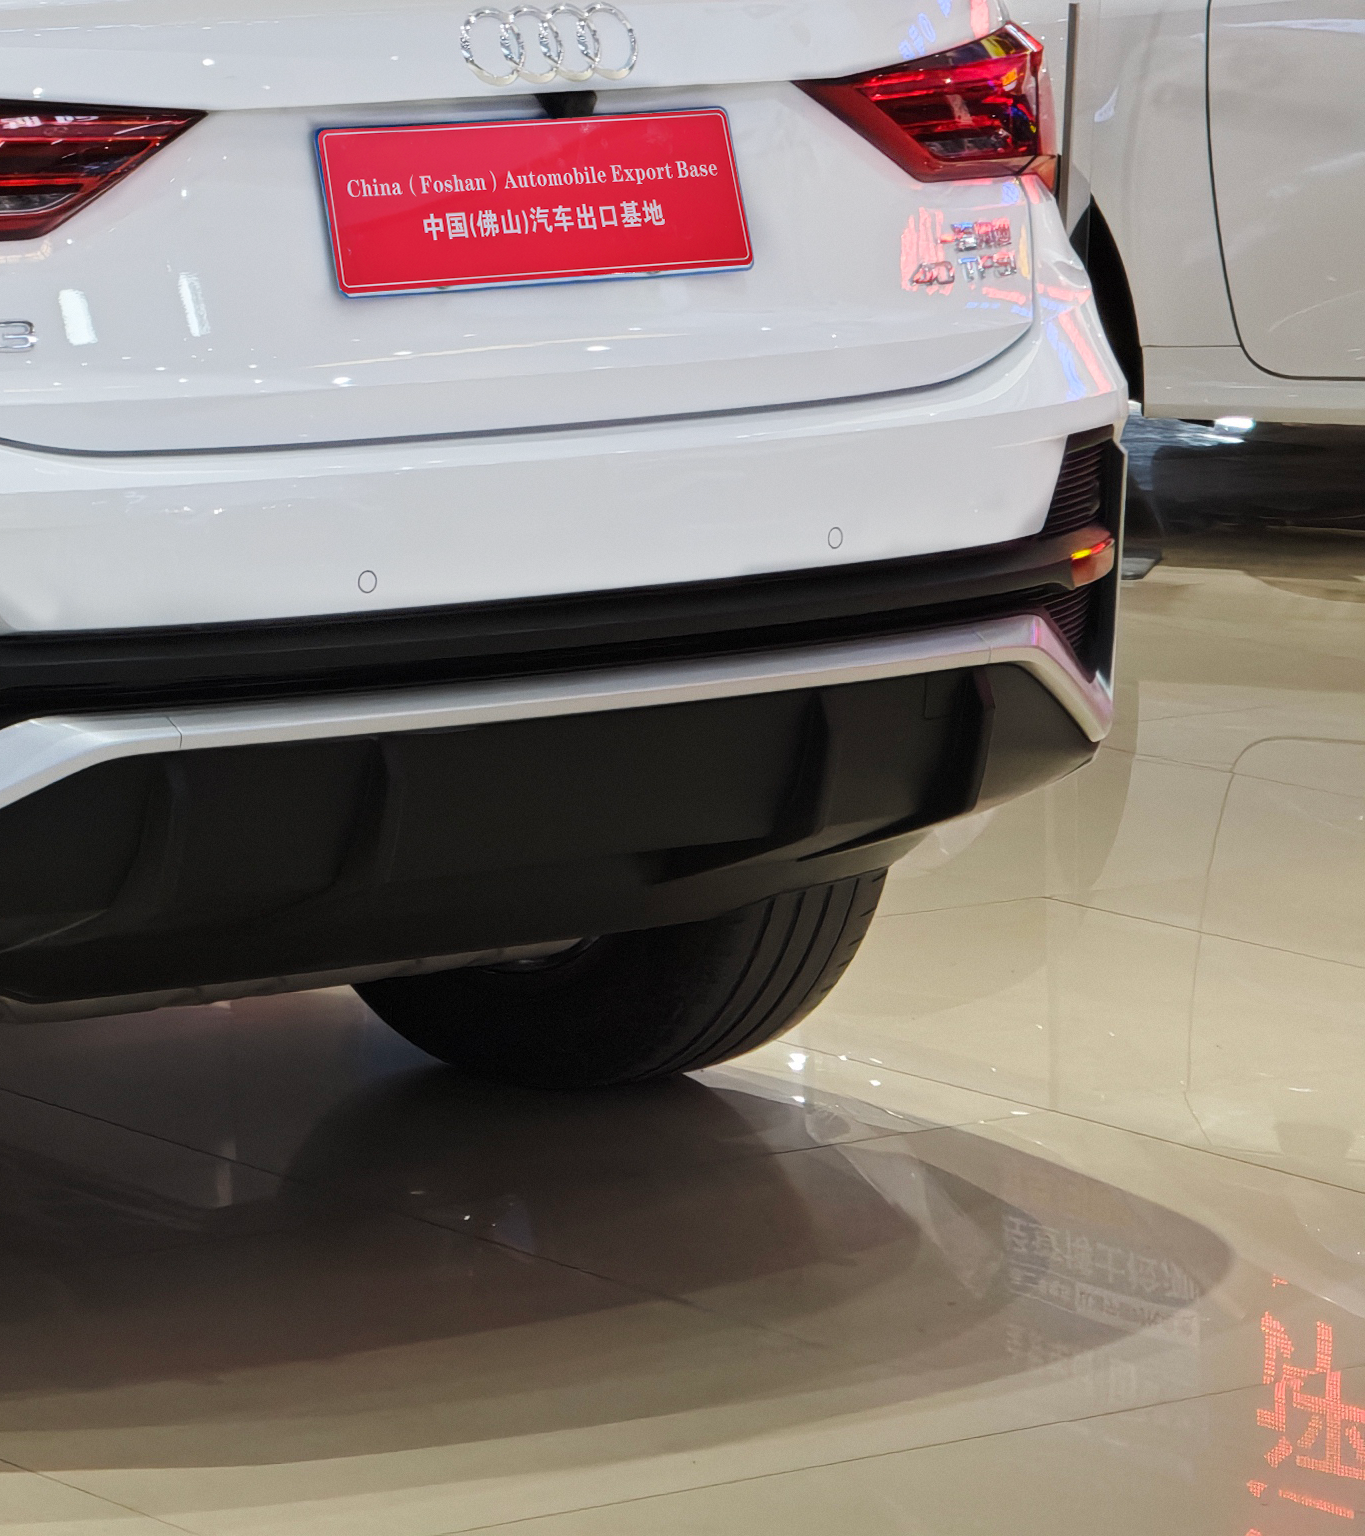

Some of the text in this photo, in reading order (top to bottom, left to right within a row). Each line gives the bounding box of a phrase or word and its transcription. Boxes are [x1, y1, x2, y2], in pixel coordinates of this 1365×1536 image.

[346, 177, 404, 199] China
[504, 167, 607, 191] Automobile
[609, 162, 674, 186] Export
[675, 160, 719, 179] Base
[422, 199, 667, 241] 中国(佛山)汽车出口基地
